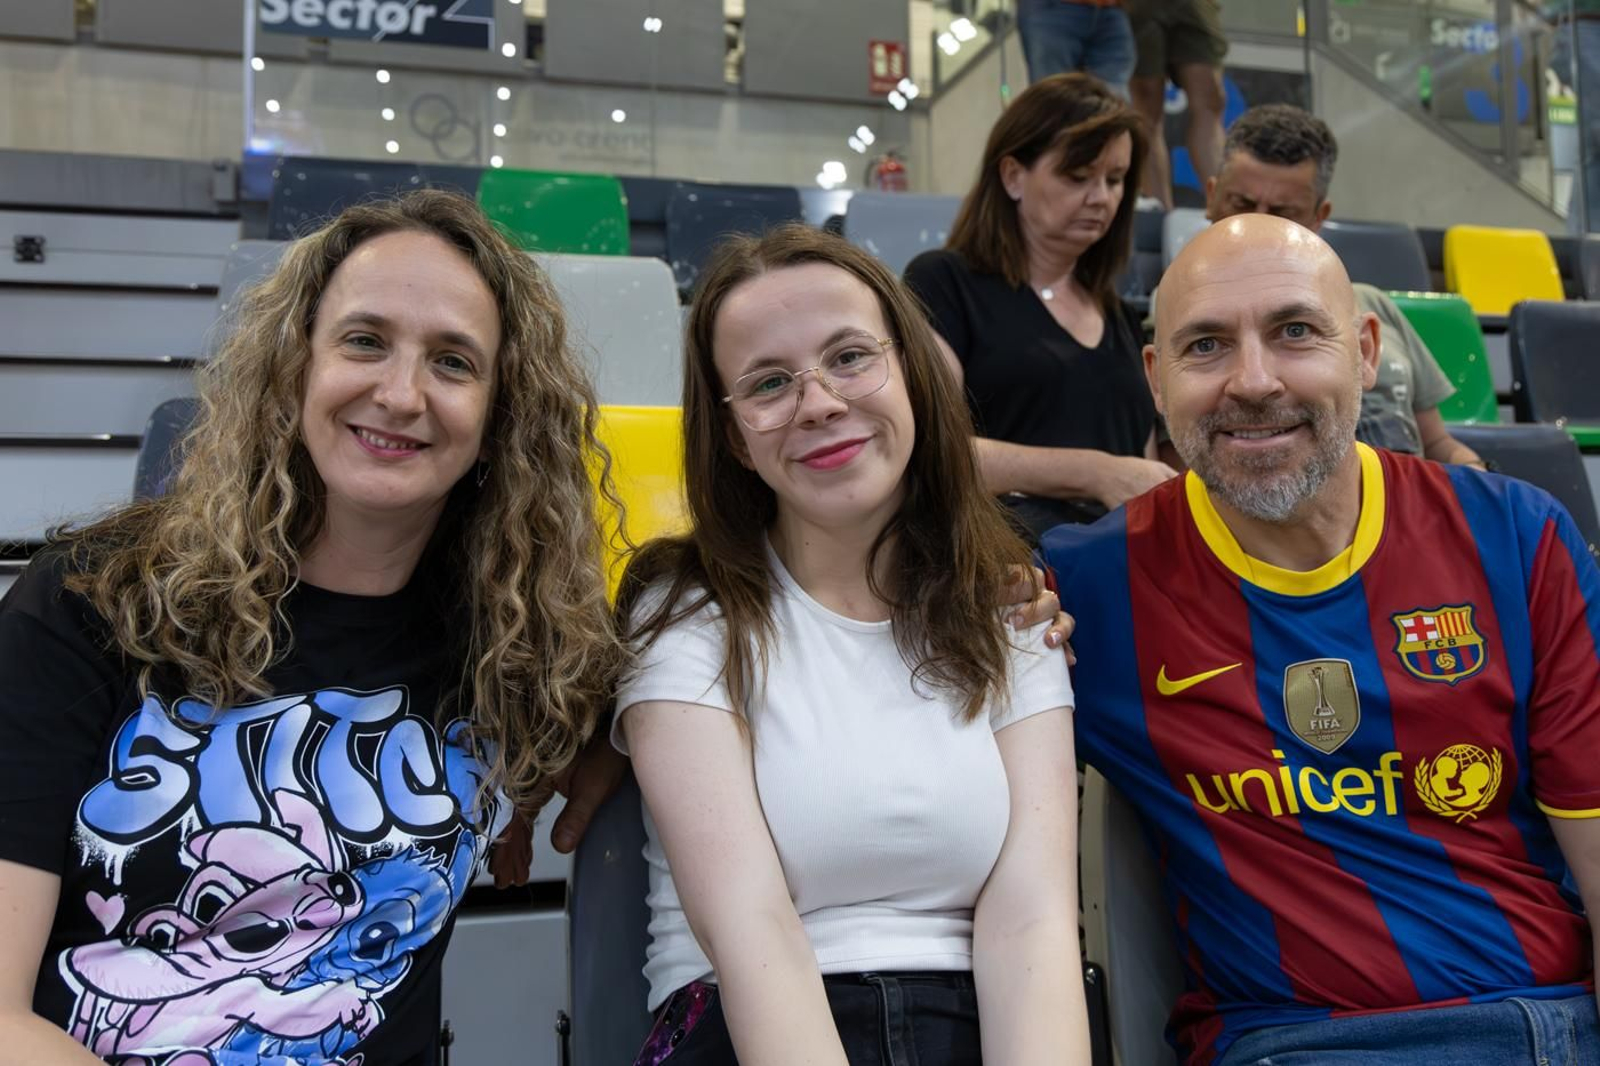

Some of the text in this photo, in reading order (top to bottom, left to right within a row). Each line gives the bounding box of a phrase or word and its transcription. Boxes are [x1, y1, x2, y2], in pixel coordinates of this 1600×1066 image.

[259, 0, 437, 35] Sector
[1430, 18, 1499, 51] Secto
[1424, 638, 1457, 649] FCB
[1310, 718, 1341, 730] FIFA
[1185, 749, 1404, 817] unicef
